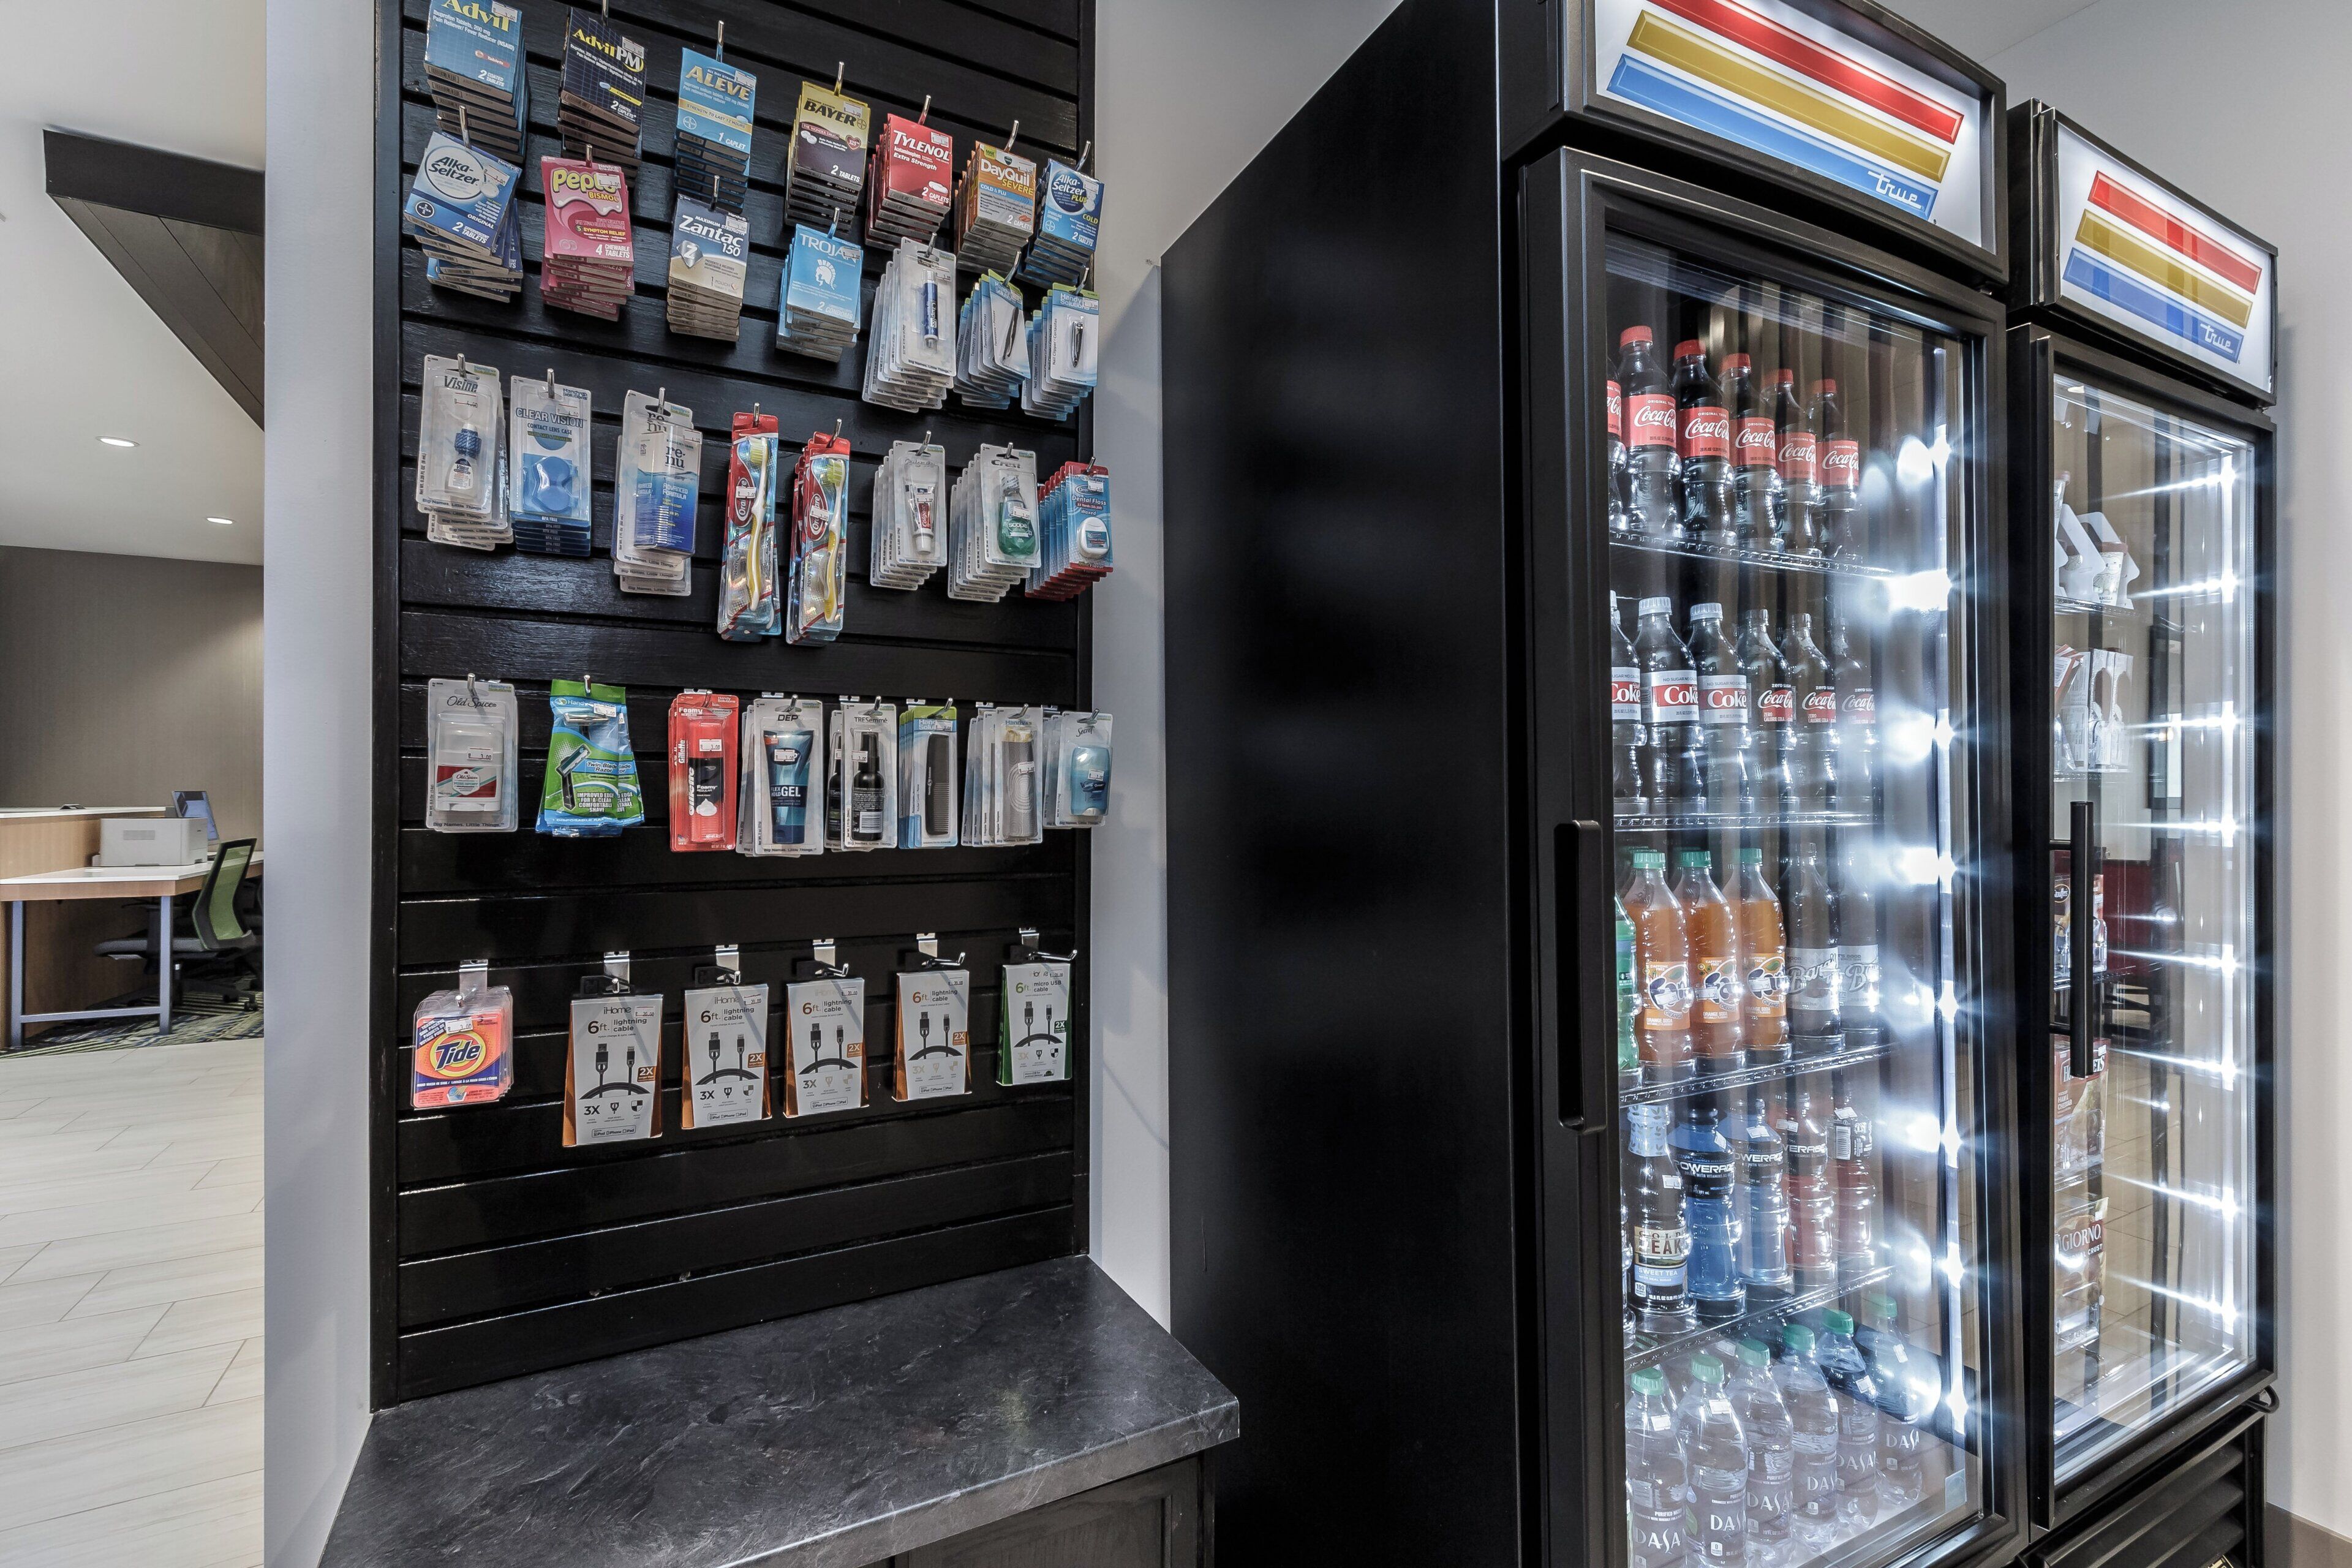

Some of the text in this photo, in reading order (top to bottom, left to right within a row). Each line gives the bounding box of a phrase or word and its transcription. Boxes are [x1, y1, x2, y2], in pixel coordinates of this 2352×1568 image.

[442, 0, 509, 32] Advil
[464, 27, 477, 36] Fever
[478, 32, 497, 43] Reducer
[573, 29, 616, 58] Advil
[616, 45, 641, 71] PM
[478, 70, 503, 81] 2 COATED
[486, 77, 504, 86] TABLETS
[685, 66, 752, 102] ALEVE
[611, 100, 619, 110] 2
[687, 104, 707, 115] STRENGTH
[732, 120, 745, 129] HOURS
[804, 100, 857, 126] BAYER
[718, 132, 745, 150] 1 CAPLET
[893, 130, 949, 161] TYLENOL
[434, 156, 473, 173] Alka-
[894, 153, 937, 170] Extra Strength
[429, 164, 480, 185] Seltzer
[831, 165, 861, 183] 2 TABLETS
[981, 159, 1030, 186] DayQuil
[1002, 179, 1033, 195] SEVERE
[1055, 175, 1080, 186] Alka-
[922, 187, 949, 203] 2 CAPLETS
[1052, 182, 1085, 195] Seltzer
[1868, 171, 1922, 209] true
[588, 192, 619, 202] BISMOL
[467, 214, 494, 229] ORIGINAL
[695, 216, 720, 227] MAXIMUM
[1007, 215, 1031, 230] 2 CAPLETS
[1082, 214, 1098, 224] COLD
[452, 222, 464, 232] 2
[679, 215, 744, 247] Zantac
[462, 229, 489, 244] TABLETS
[1072, 232, 1078, 240] 2
[596, 244, 602, 255] 4
[605, 250, 630, 258] TABLETS
[722, 243, 741, 257] 150
[800, 233, 856, 263] TROJA
[818, 301, 853, 319] 2 CONDOMS
[2200, 323, 2233, 353] true
[444, 375, 478, 393] Visine
[516, 408, 583, 428] CLEAR VISION
[991, 459, 1020, 469] Crest
[663, 483, 688, 494] ADVANCED
[663, 490, 687, 500] FORMULA
[447, 696, 493, 708] Old Spice
[1707, 690, 1746, 708] Coke
[1076, 725, 1095, 737] Secret
[781, 786, 801, 797] GEL
[435, 1040, 481, 1071] Tide
[639, 1067, 654, 1076] 2X
[803, 1079, 816, 1089] 3X
[700, 1090, 715, 1101] 3X
[584, 1105, 600, 1116] 3X
[1639, 1240, 1682, 1254] EAK
[2088, 1244, 2102, 1255] CRUST
[1887, 1429, 1920, 1452] DASA
